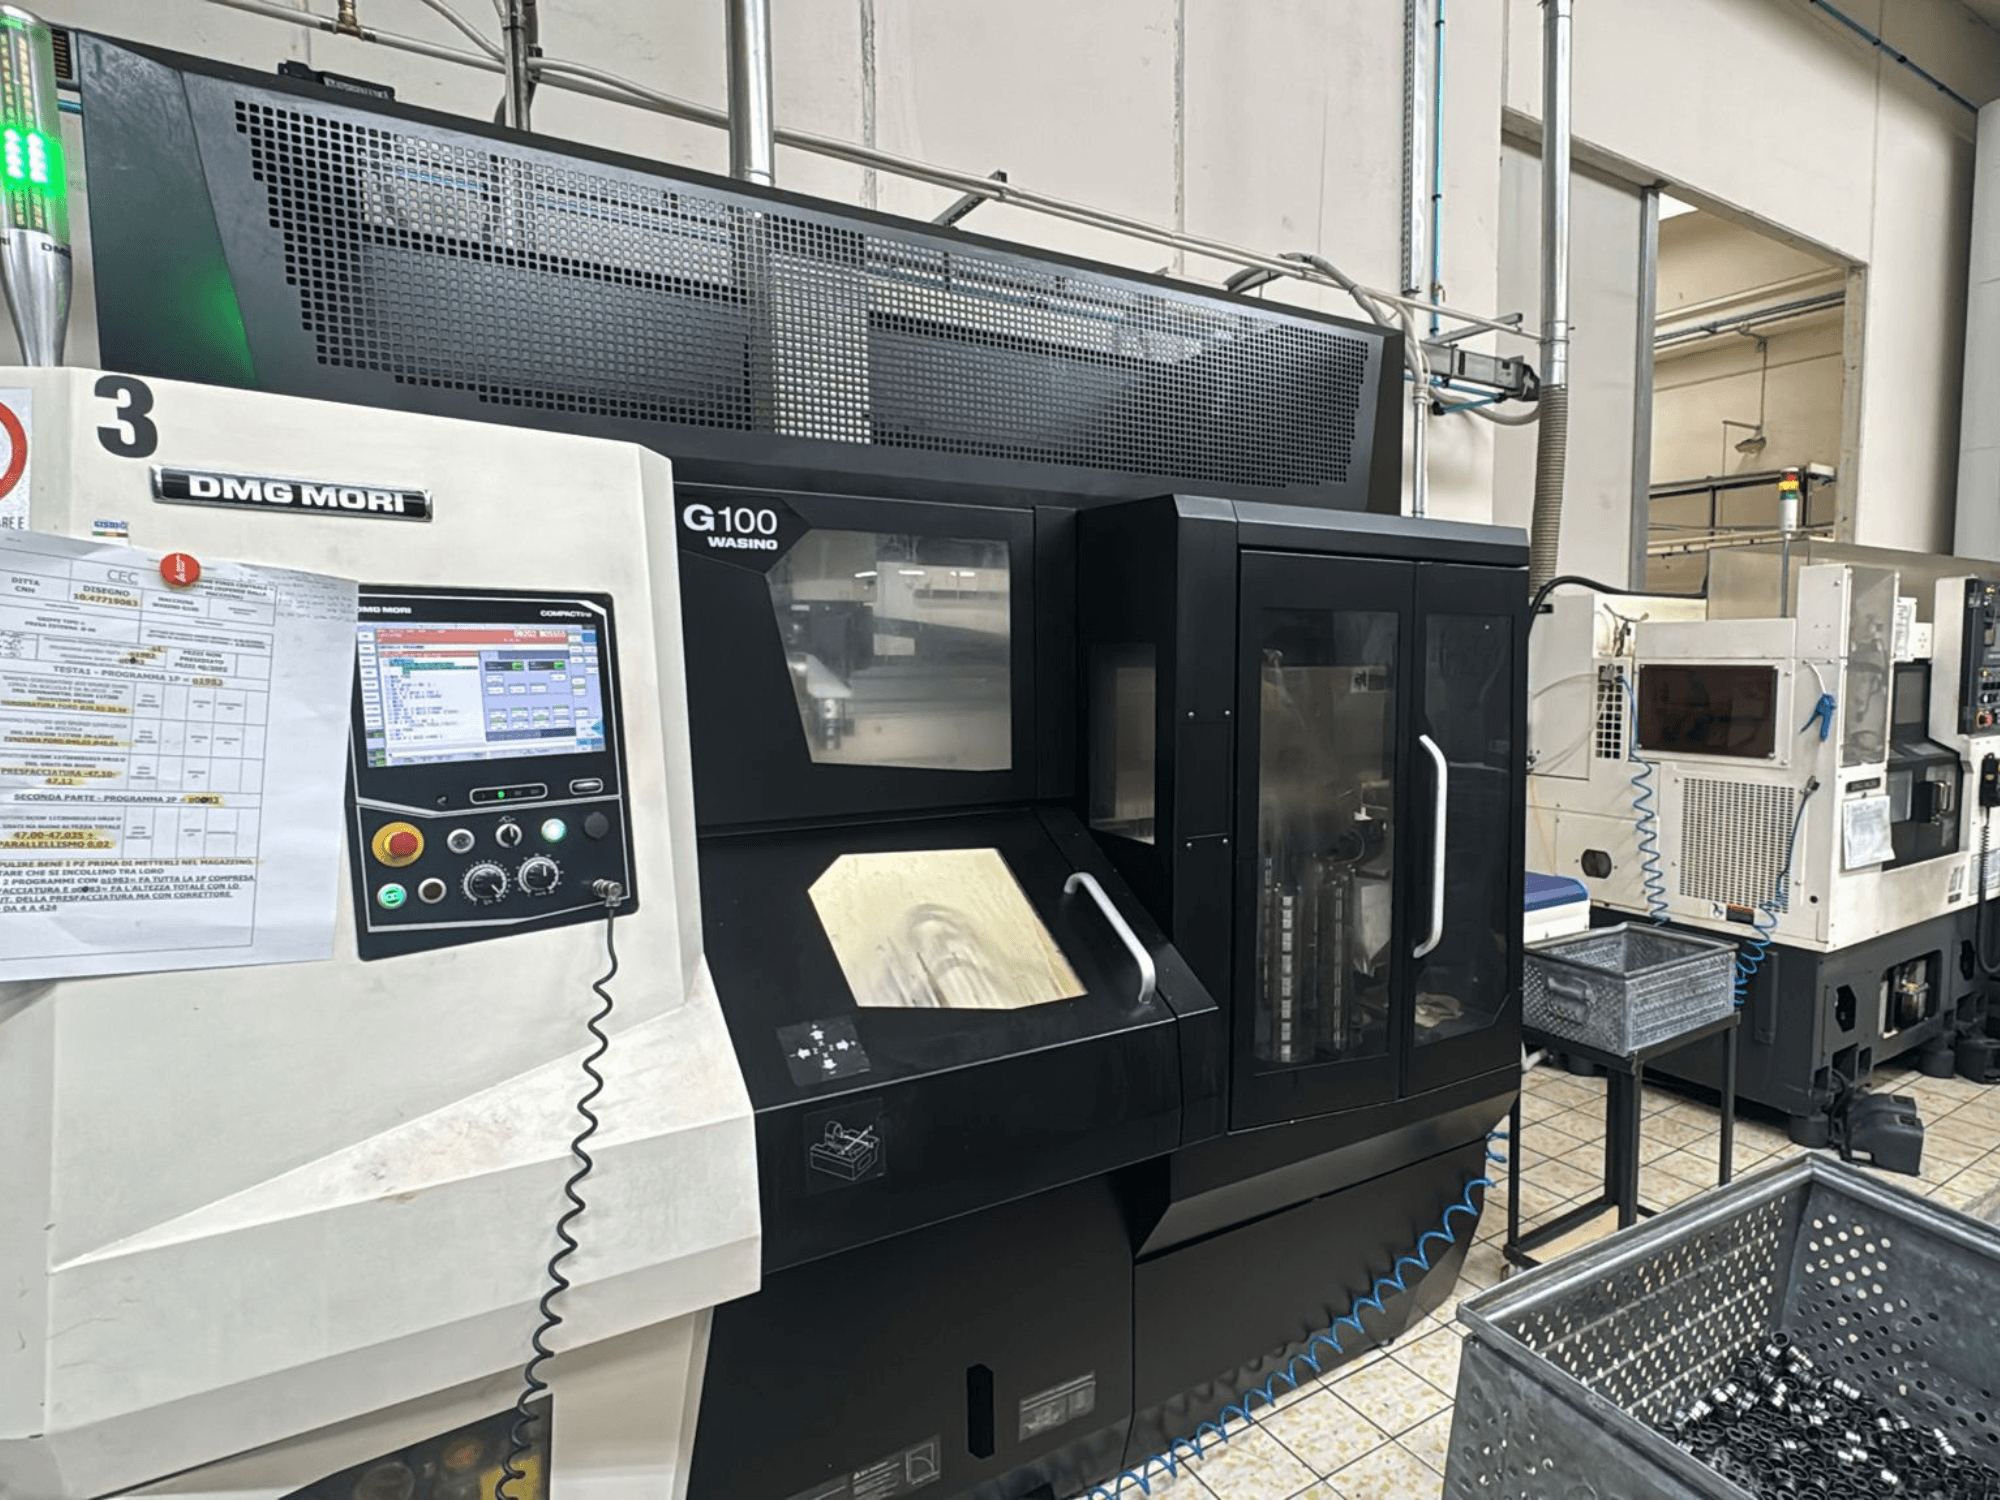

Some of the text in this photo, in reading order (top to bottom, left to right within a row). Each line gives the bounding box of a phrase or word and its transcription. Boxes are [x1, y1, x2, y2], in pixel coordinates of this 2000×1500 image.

[94, 375, 158, 459] 3
[188, 475, 405, 513] DMG MORI
[683, 503, 778, 535] G100
[707, 536, 778, 551] WASINO
[11, 577, 41, 587] DITTA
[82, 584, 131, 597] DISEGNO
[382, 606, 412, 614] MORI
[101, 669, 166, 682] PROGRAMMA
[13, 793, 62, 801] SECONDA
[64, 794, 95, 802] PARTE
[103, 795, 164, 803] PROGRAMMA
[181, 859, 199, 867] NEL
[11, 878, 75, 886] PROGRAMMI
[77, 877, 98, 885] CON
[208, 874, 255, 882] COMPRESA
[172, 883, 205, 891] TOTALE
[15, 895, 47, 903] DELLA
[49, 893, 133, 903] PRESFACCIATURA
[136, 892, 151, 900] MA
[3, 905, 18, 913] DA
